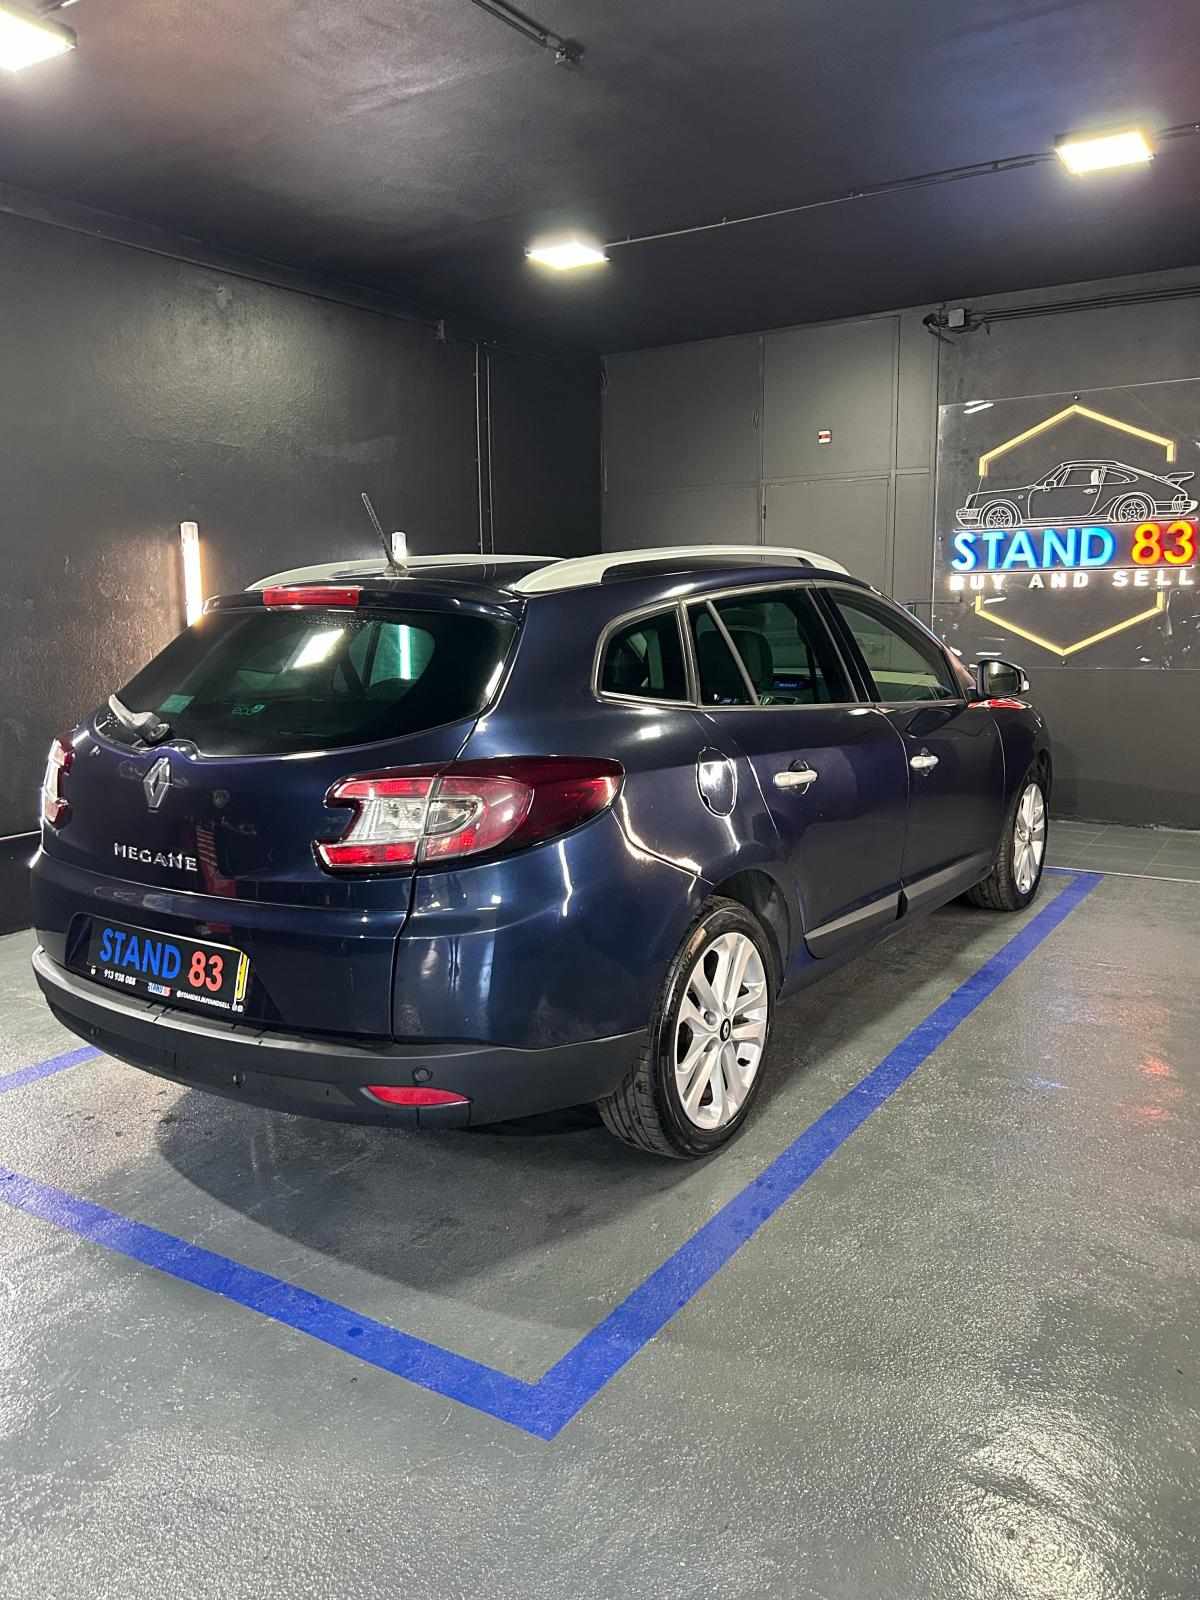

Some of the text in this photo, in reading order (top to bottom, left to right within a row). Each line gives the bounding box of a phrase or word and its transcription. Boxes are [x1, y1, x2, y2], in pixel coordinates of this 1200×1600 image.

[951, 520, 1195, 571] STAND 83
[949, 569, 1195, 591] BUY AND SELL
[113, 842, 199, 872] MEGANE
[99, 928, 224, 992] STAND 83
